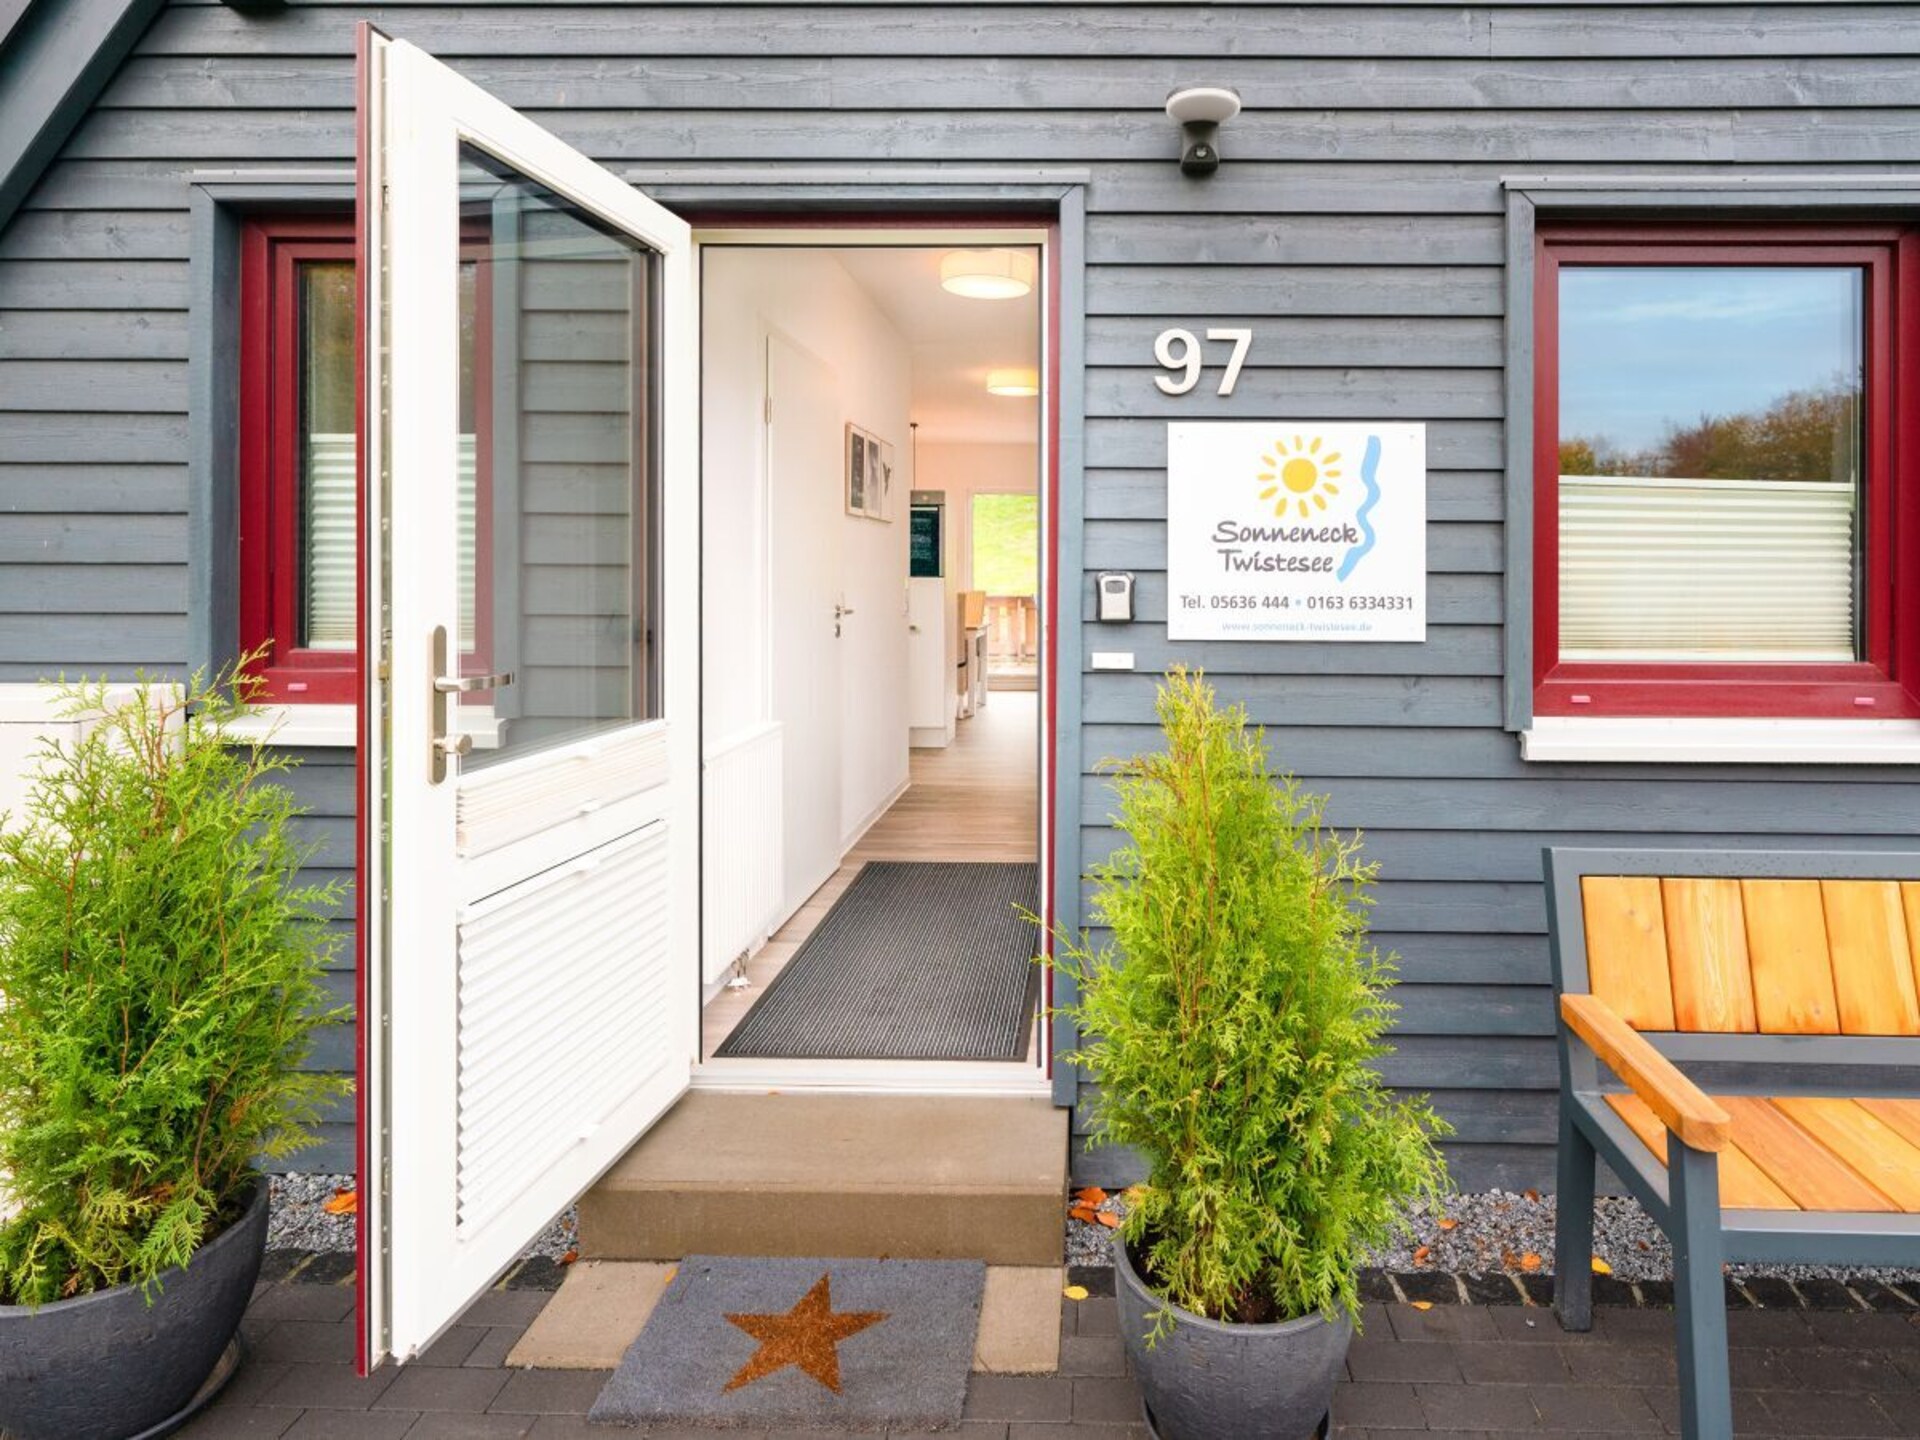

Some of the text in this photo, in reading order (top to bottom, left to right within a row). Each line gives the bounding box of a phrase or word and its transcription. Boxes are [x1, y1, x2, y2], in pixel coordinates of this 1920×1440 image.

[1154, 328, 1252, 395] 97
[1211, 520, 1358, 544] Sonneneck
[1217, 549, 1334, 573] Twistesee
[1181, 595, 1413, 610] Tel. 05636 444 0163 6334331
